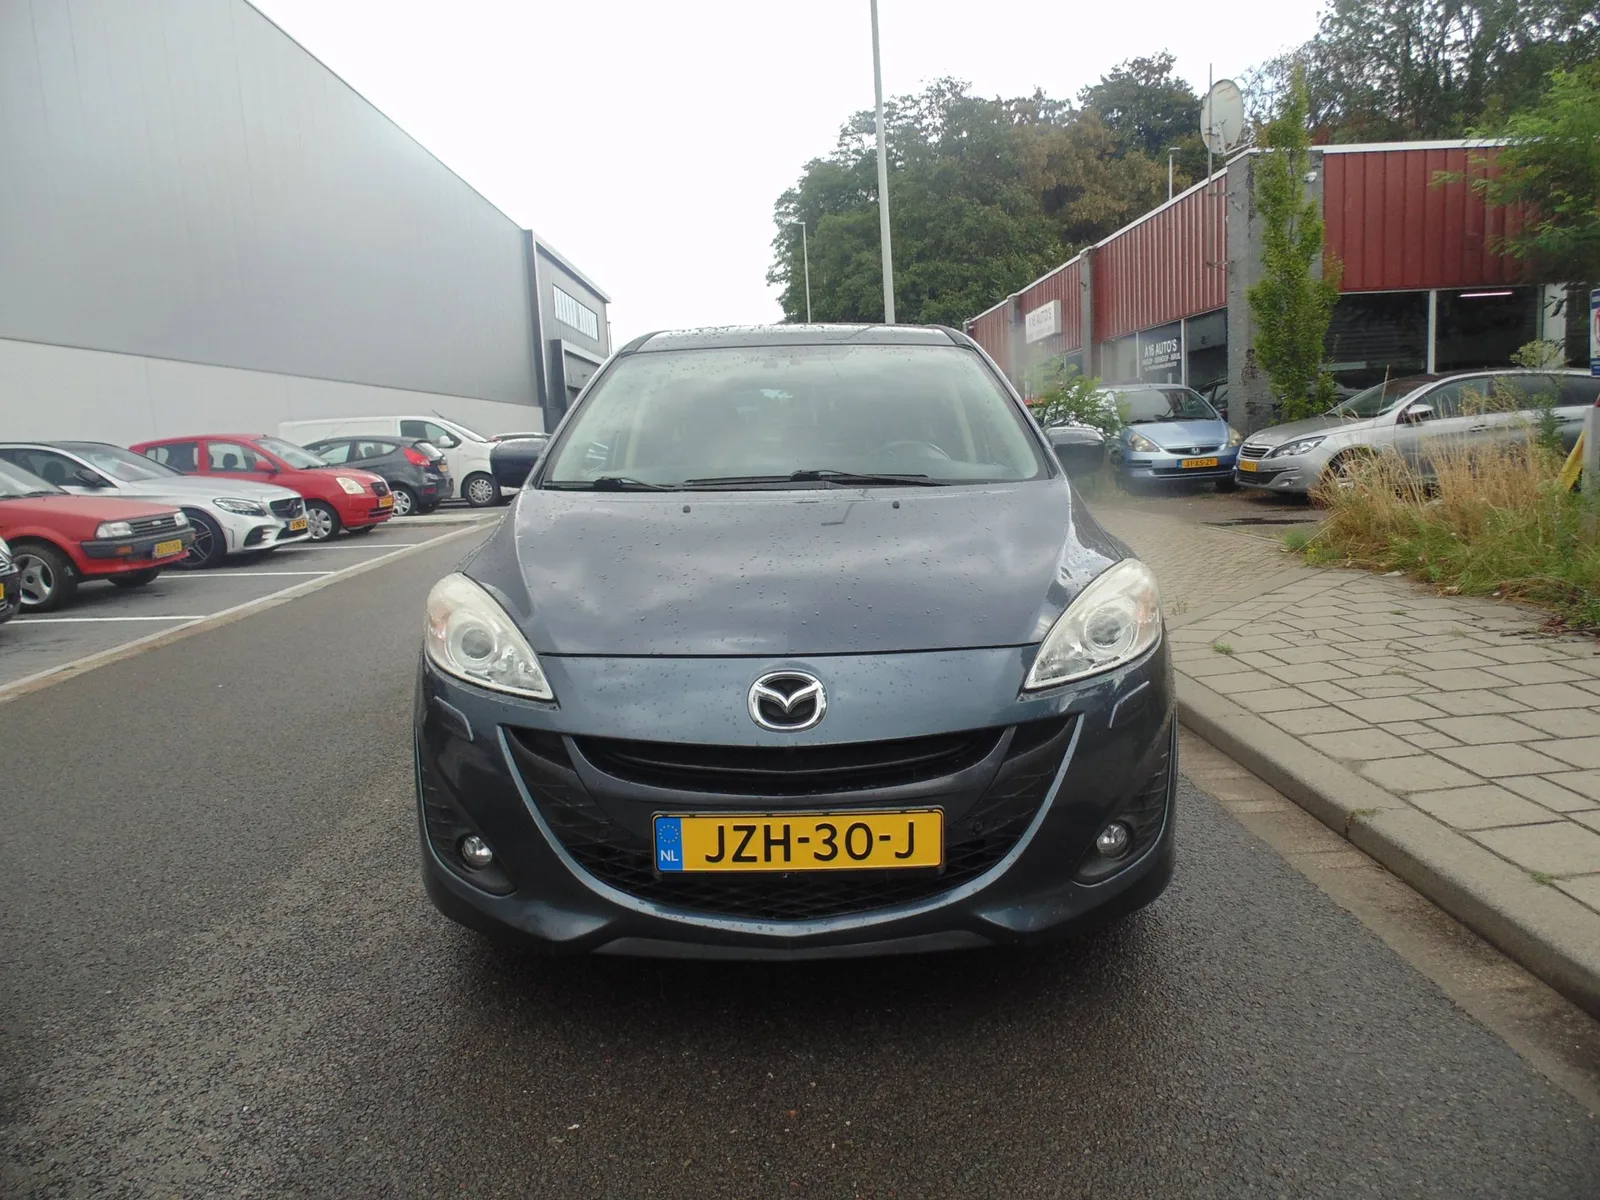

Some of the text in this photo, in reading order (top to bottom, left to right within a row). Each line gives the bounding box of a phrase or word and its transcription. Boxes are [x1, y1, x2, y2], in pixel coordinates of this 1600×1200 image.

[1155, 339, 1178, 356] AUTO'S
[705, 821, 915, 863] JZH-30-J
[660, 850, 679, 862] NL
